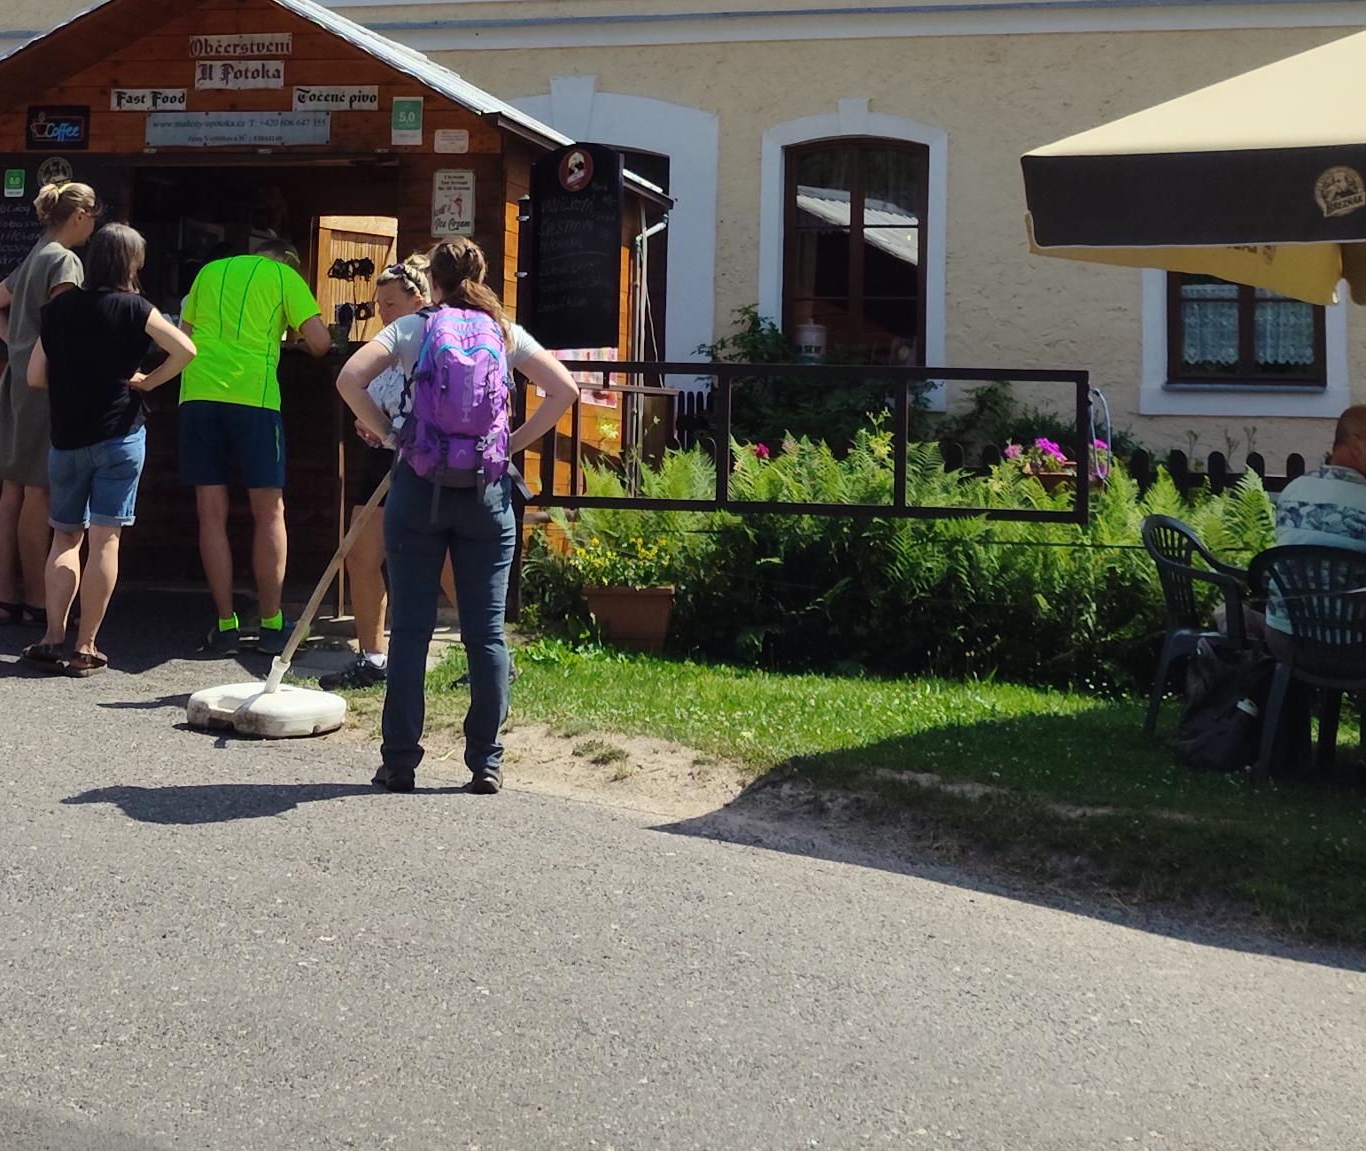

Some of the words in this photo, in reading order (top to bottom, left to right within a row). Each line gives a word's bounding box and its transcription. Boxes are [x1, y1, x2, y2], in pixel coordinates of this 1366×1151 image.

[197, 63, 213, 83] U
[219, 63, 281, 85] Potoka
[115, 91, 146, 108] Fast
[150, 91, 186, 109] Food
[297, 88, 345, 104] Točené
[349, 92, 377, 108] pivo
[46, 123, 80, 142] Coffee
